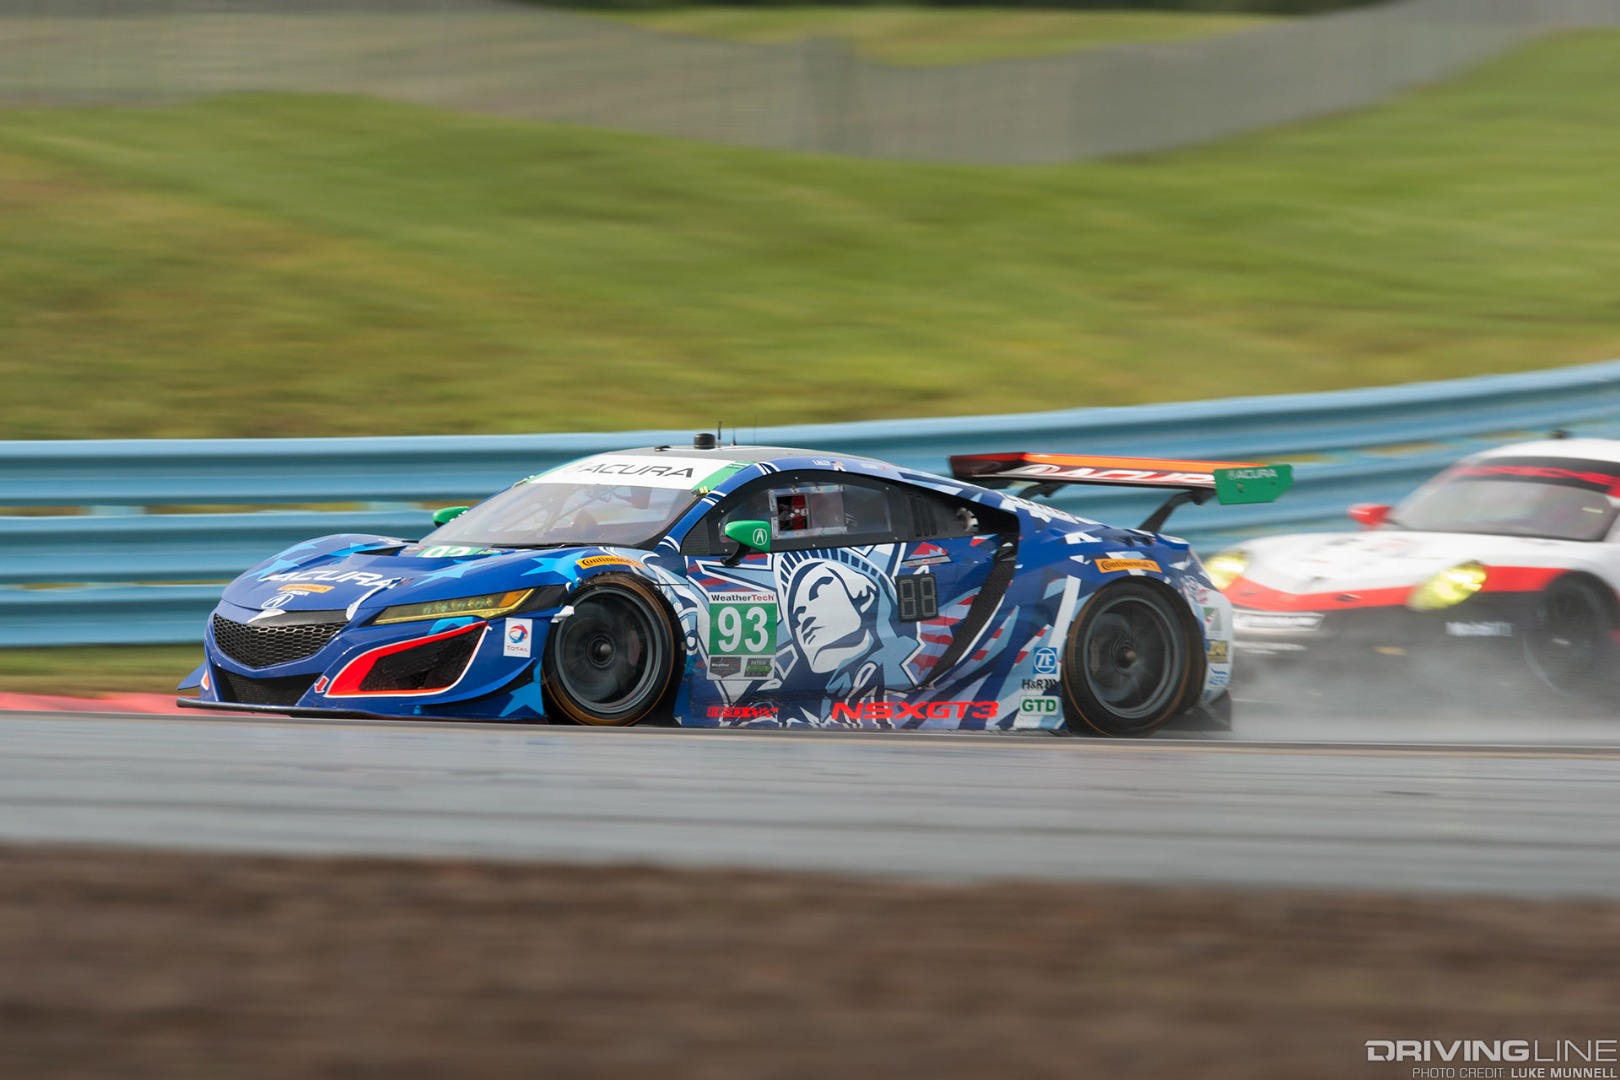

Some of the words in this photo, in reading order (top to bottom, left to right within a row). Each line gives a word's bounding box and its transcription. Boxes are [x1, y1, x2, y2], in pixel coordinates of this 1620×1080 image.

[579, 463, 694, 478] ACURA
[1236, 468, 1279, 479] ACURA
[257, 570, 405, 590] ACURA
[711, 594, 774, 602] WeatherTech
[717, 606, 769, 653] 93
[1022, 699, 1057, 712] GTD
